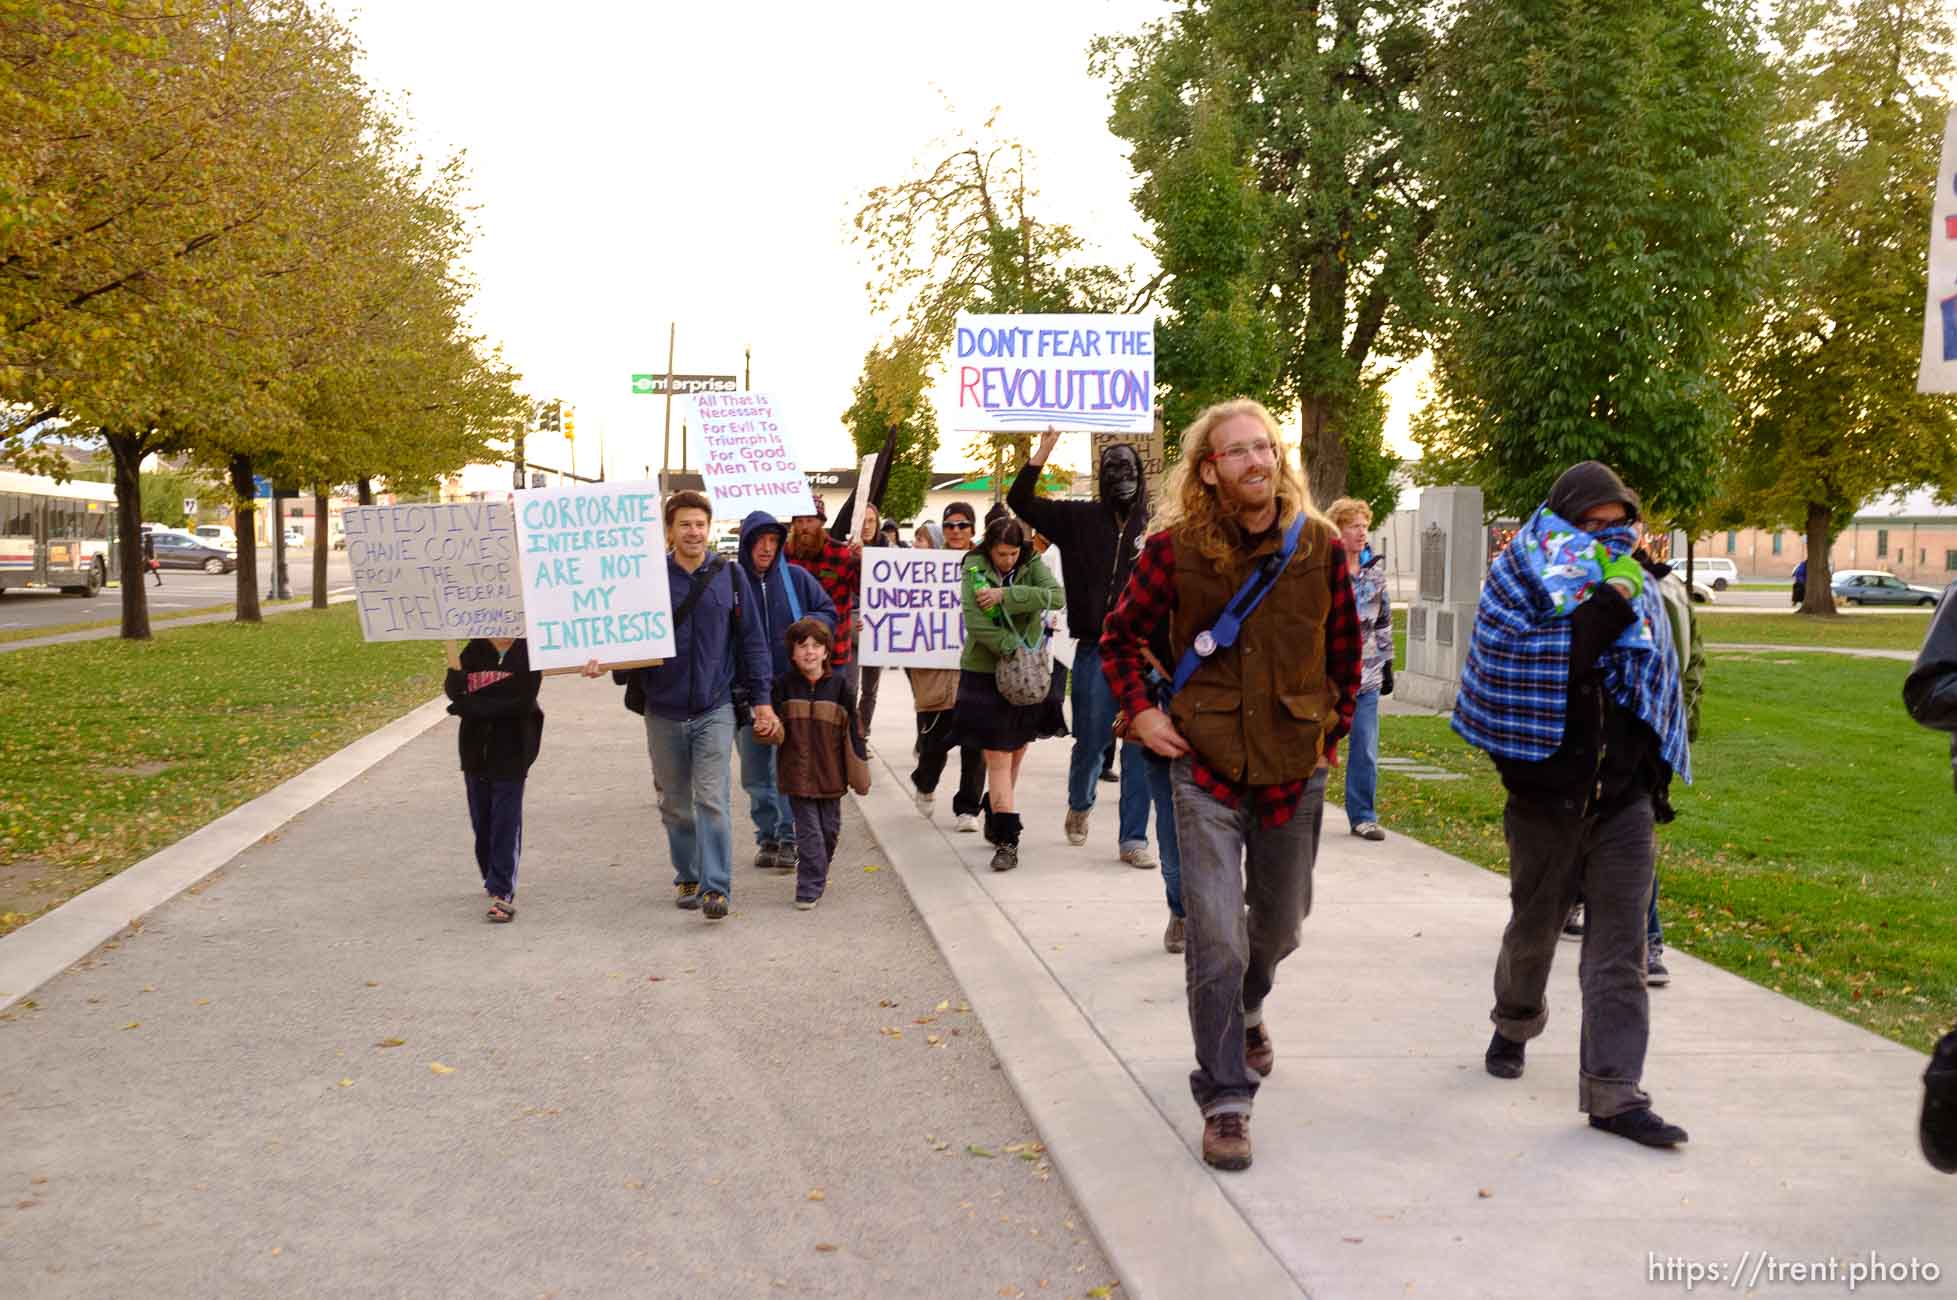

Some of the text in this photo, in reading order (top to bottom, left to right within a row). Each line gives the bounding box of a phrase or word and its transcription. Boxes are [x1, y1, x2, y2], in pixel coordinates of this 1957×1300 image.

[958, 326, 1152, 358] DON'T FEAR THE
[719, 395, 752, 406] That
[756, 394, 768, 404] Is
[960, 366, 1149, 411] REVOLUTION
[699, 407, 773, 420] Necessary
[703, 423, 726, 434] For
[759, 421, 777, 431] To
[705, 433, 782, 446] Triumph Is
[710, 445, 785, 461] For Good
[705, 460, 796, 476] Men To Do
[344, 505, 511, 535] EFFECTIVE
[523, 494, 656, 529] CORPORATE
[425, 536, 511, 561] COMES
[528, 527, 646, 552] INTERESTS
[354, 562, 511, 587] FROM THE TOP
[535, 554, 648, 588] ARE NOT
[873, 560, 936, 583] OVER
[444, 584, 520, 601] FEDERAL
[572, 586, 616, 612] MY
[867, 587, 933, 609] UNDER
[360, 588, 444, 635] FIRE!
[536, 611, 666, 650] INTERESTS
